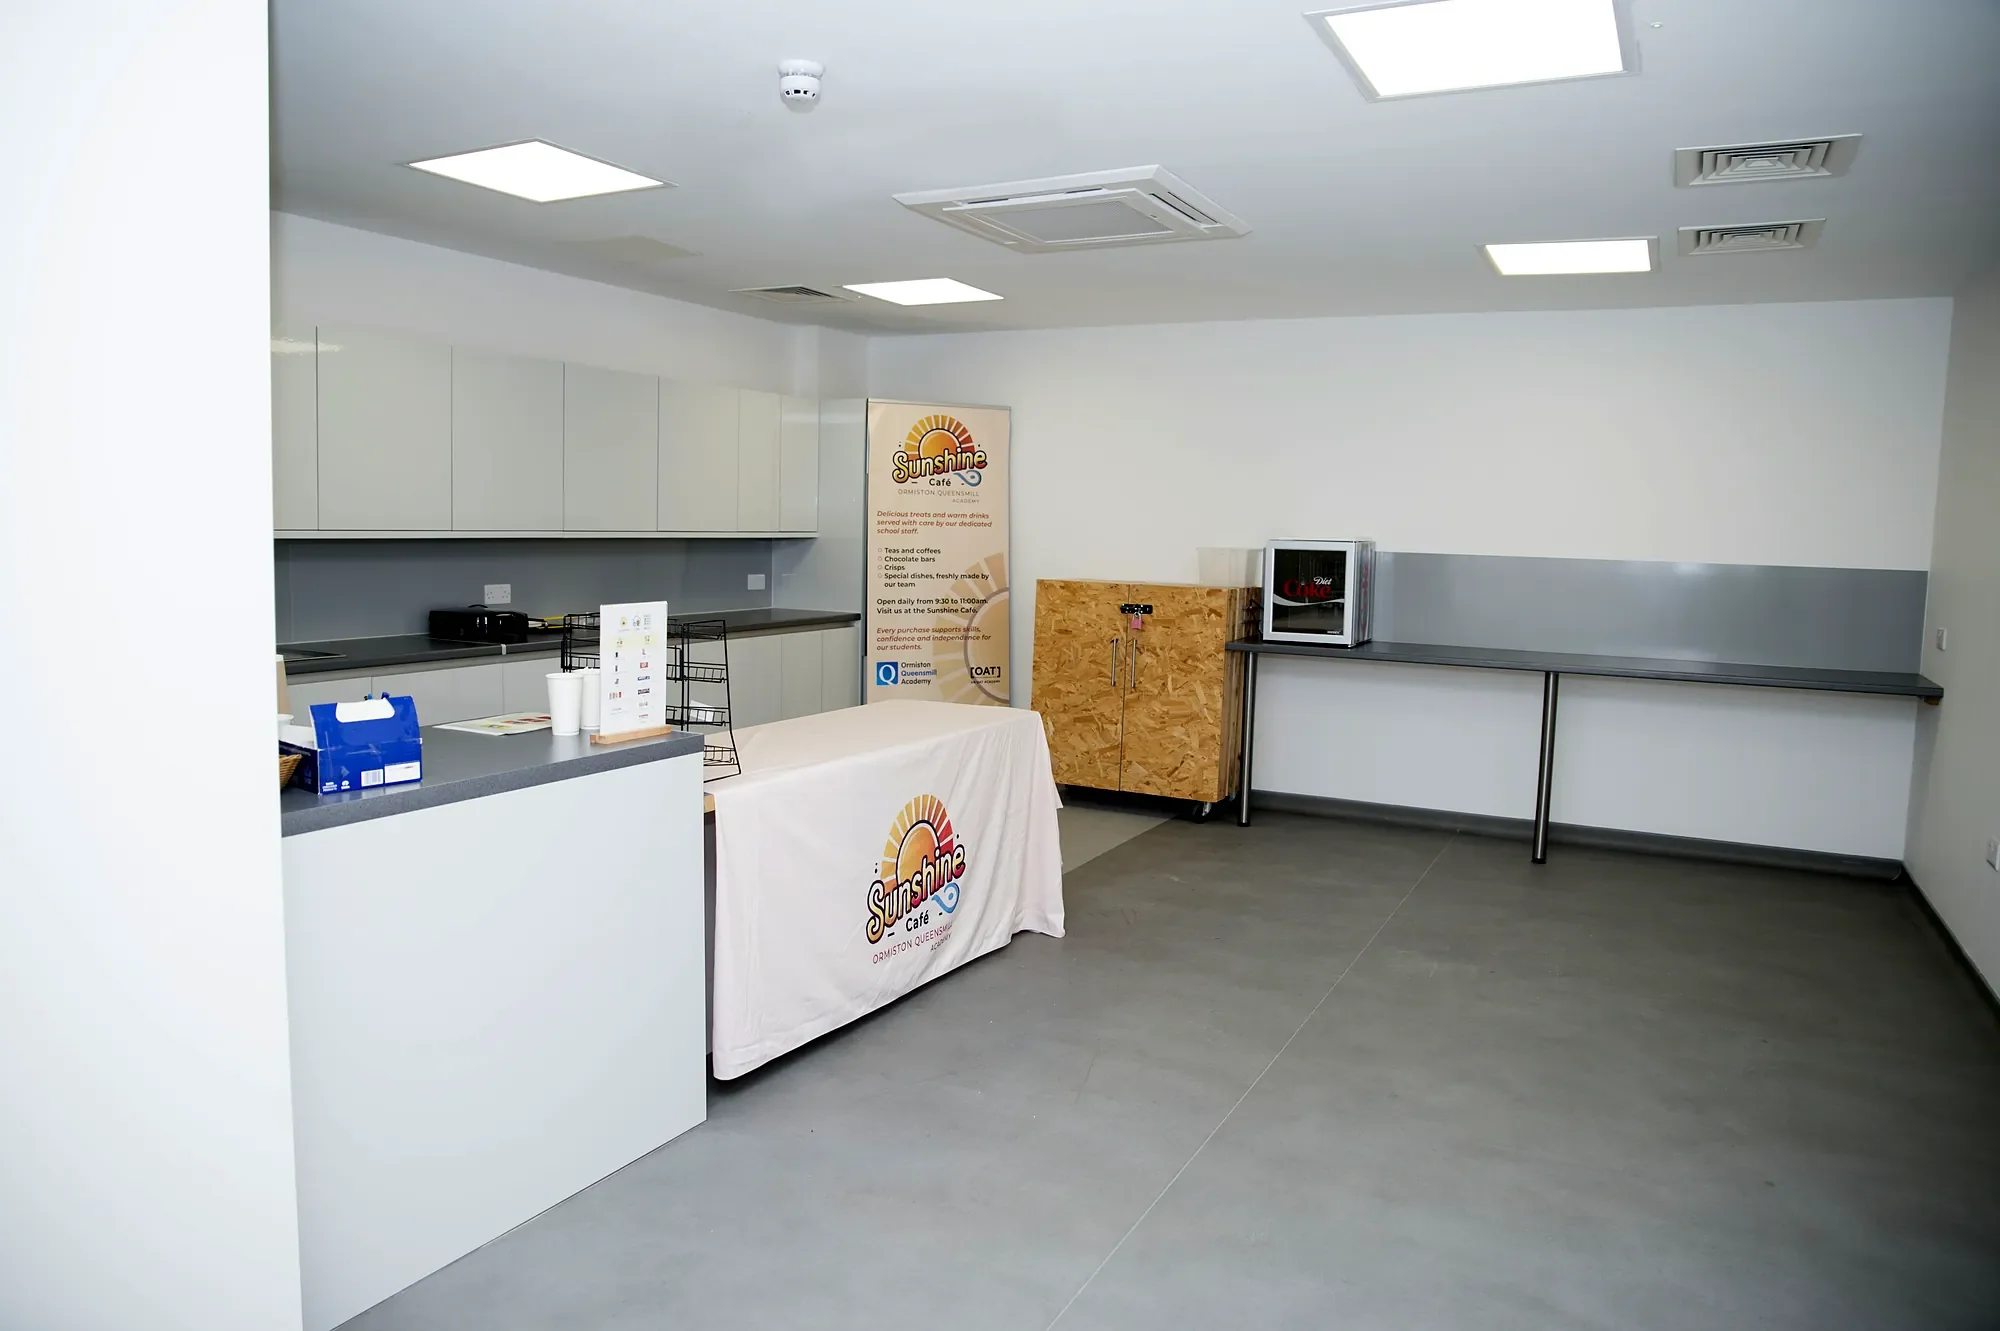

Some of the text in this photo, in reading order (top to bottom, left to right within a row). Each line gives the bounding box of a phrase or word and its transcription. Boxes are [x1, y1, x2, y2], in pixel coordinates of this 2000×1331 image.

[892, 447, 988, 484] Sunshine
[929, 478, 952, 487] Café
[936, 520, 944, 528] by
[981, 573, 989, 581] by
[1313, 576, 1333, 585] Diet
[1283, 579, 1332, 598] Coke
[876, 598, 896, 606] Open
[897, 598, 915, 606] daily
[932, 634, 981, 642] independence
[879, 664, 896, 685] Q
[901, 669, 937, 677] Queensmill
[865, 843, 966, 945] Sunshine
[905, 909, 930, 932] Café
[872, 939, 913, 964] ORMISTON
